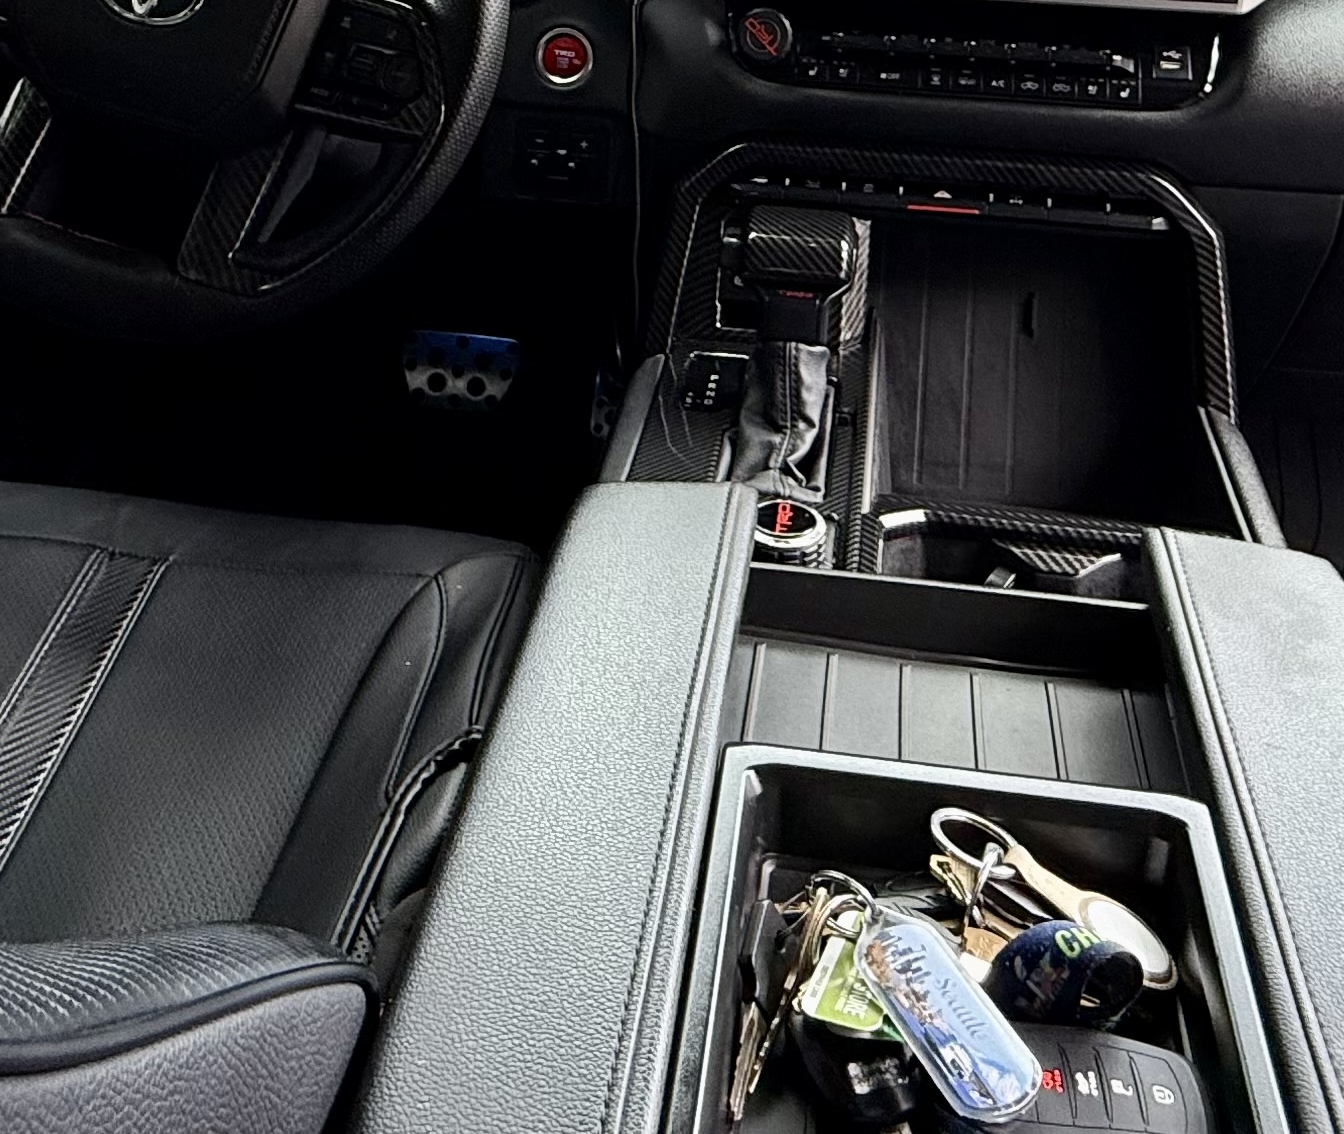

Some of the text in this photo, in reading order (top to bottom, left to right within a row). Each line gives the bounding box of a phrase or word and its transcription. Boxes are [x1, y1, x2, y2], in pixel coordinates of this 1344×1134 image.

[553, 48, 576, 59] TRD
[991, 78, 1005, 88] A/C
[933, 978, 987, 1038] Seattle
